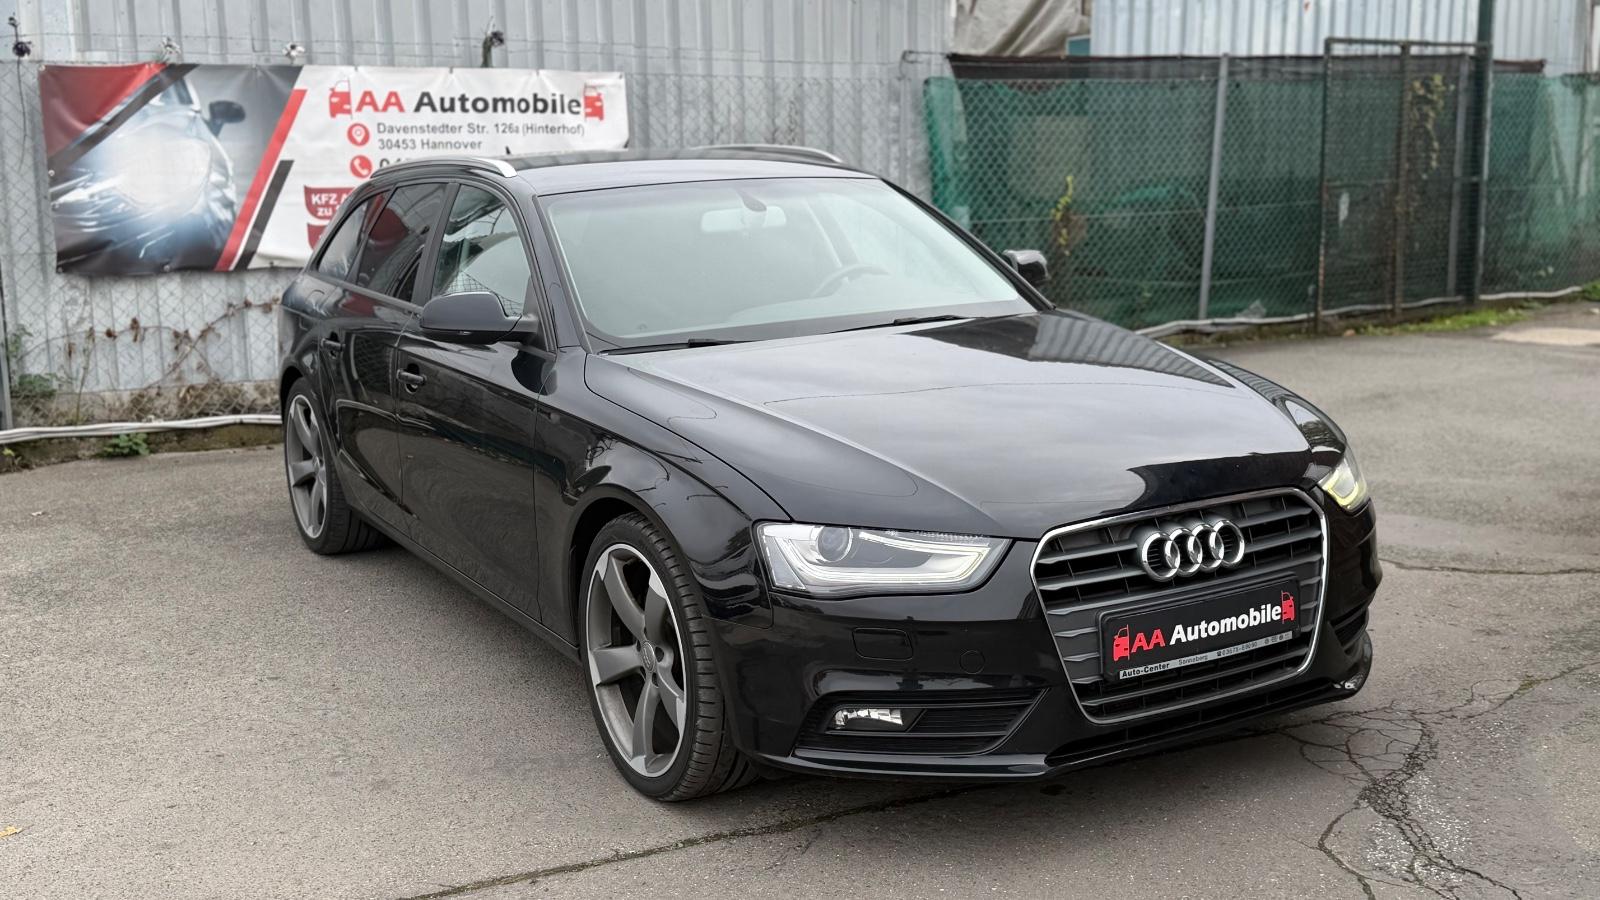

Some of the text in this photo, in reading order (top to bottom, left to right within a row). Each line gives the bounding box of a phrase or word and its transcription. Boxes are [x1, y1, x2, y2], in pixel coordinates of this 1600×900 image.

[355, 90, 582, 115] AA Automobile
[377, 122, 585, 136] Davenstedter Str. 126a (Hinterhof)
[378, 139, 482, 150] 30453 Hannover
[311, 193, 337, 205] KFZ
[1131, 603, 1282, 653] AA Automobile
[1122, 663, 1170, 678] Auto-Center
